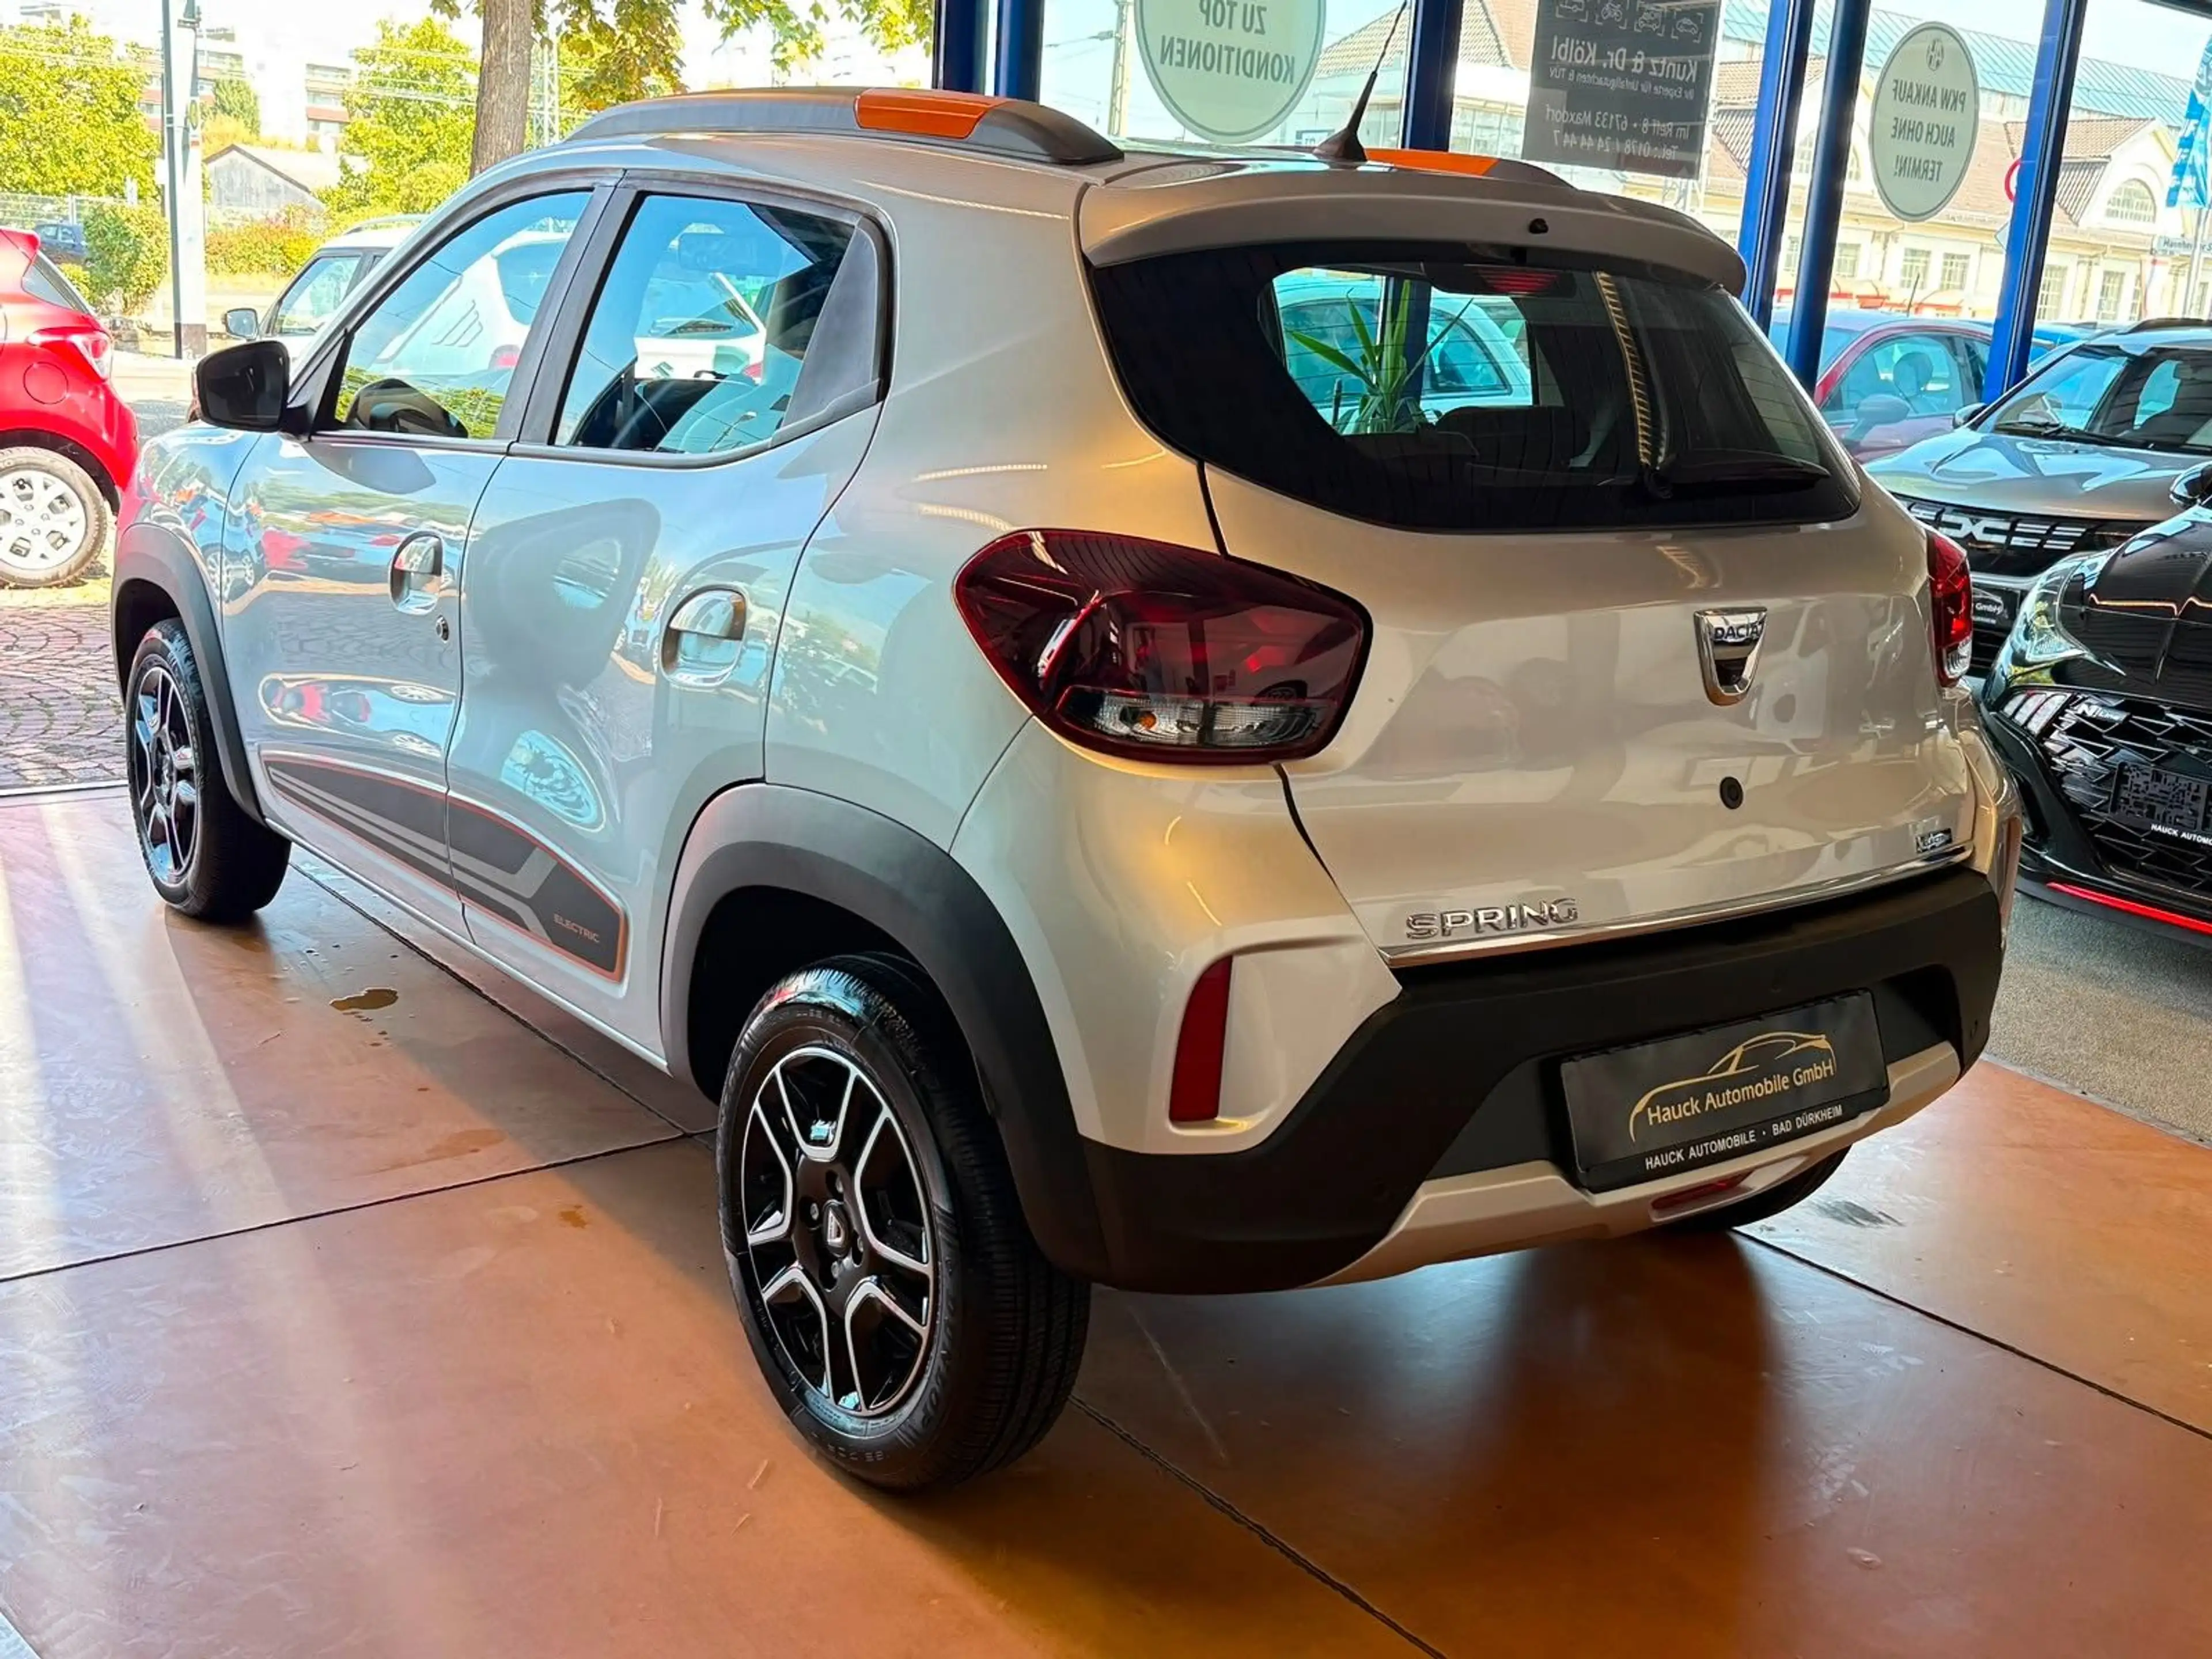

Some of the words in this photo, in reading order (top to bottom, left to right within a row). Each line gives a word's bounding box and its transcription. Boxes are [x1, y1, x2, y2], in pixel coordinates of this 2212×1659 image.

[1714, 624, 1760, 639] DACIA
[2150, 824, 2179, 837] HAUCK
[553, 913, 601, 944] ELECTRIC
[1406, 897, 1578, 940] SPRING
[1647, 1096, 1702, 1126] Hauck
[1704, 1074, 1790, 1112] Automobile
[1792, 1058, 1835, 1087] GmbH
[1645, 1149, 1685, 1171] HAUCK
[1688, 1130, 1756, 1160] AUTOMOBILE
[1771, 1119, 1793, 1137] BAD
[1796, 1104, 1843, 1130] DÜRKHEIM
